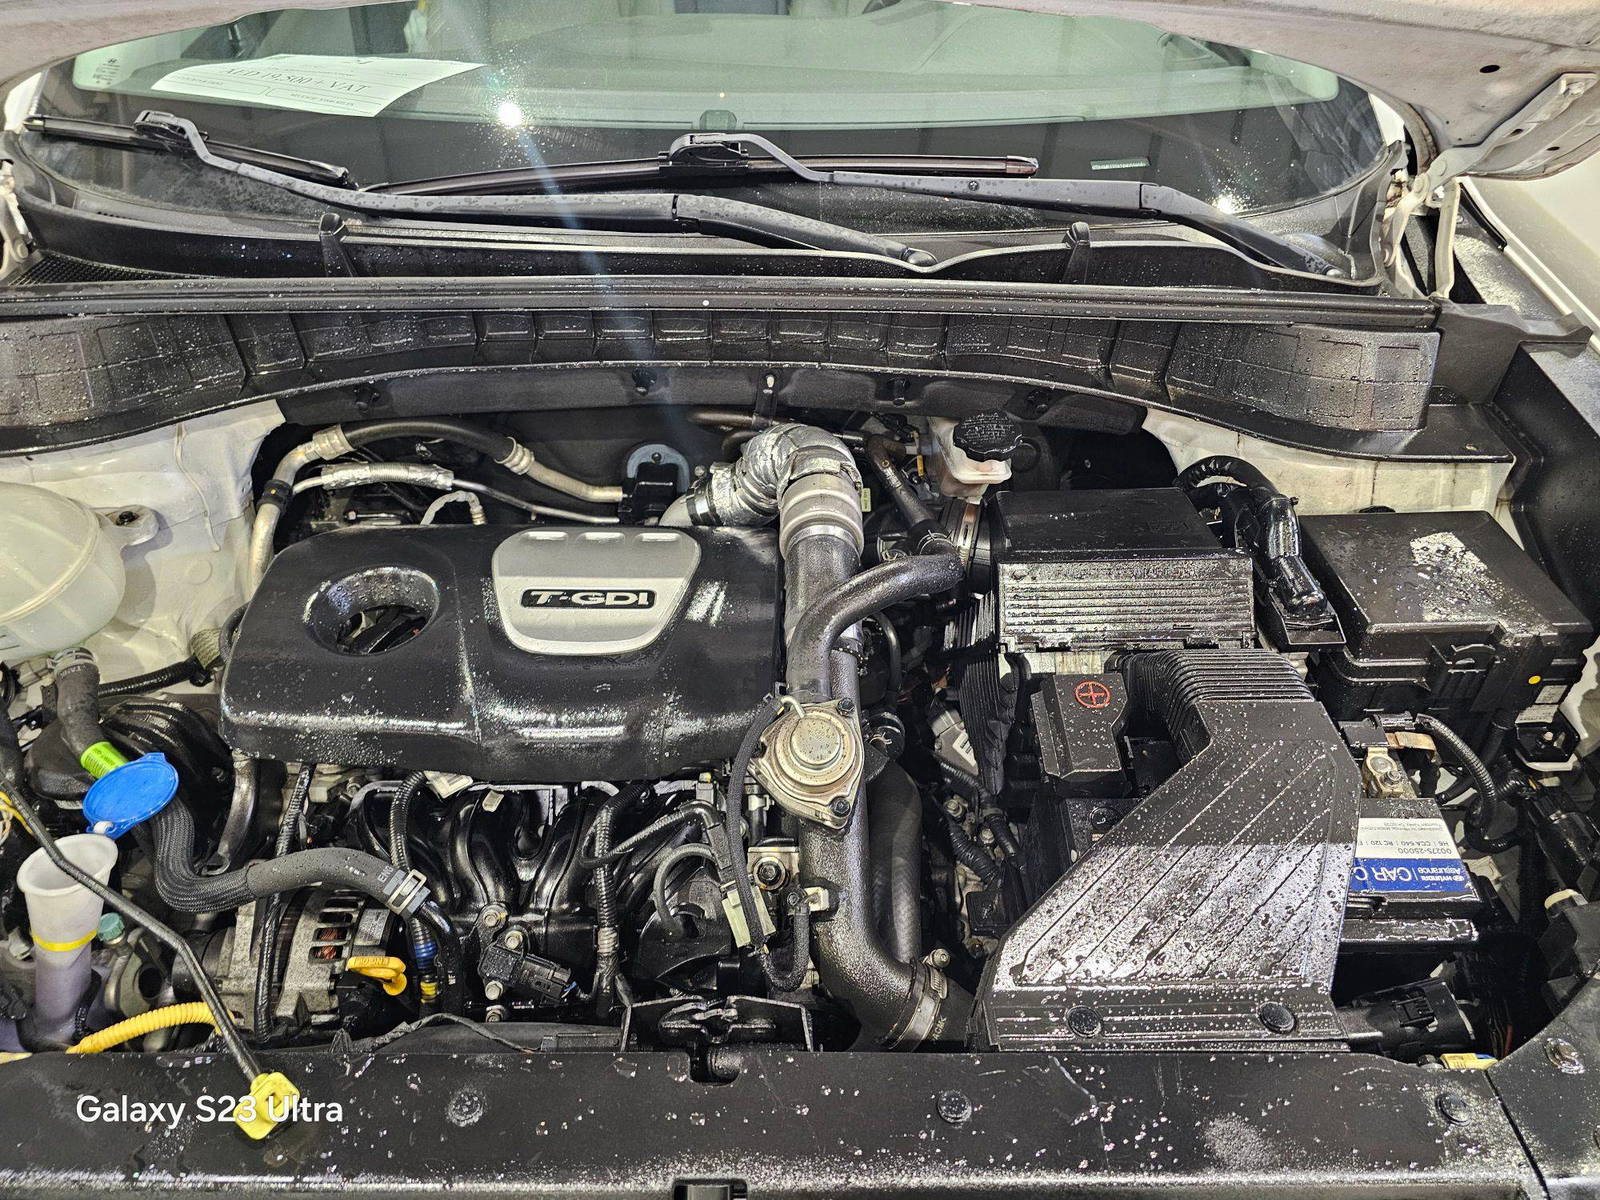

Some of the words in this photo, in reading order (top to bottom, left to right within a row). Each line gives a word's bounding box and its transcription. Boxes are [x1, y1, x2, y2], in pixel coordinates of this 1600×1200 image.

[225, 67, 261, 76] AED
[330, 81, 370, 92] VAT
[531, 590, 649, 605] T-GDI
[377, 865, 394, 883] ENG
[1371, 866, 1412, 881] CAR
